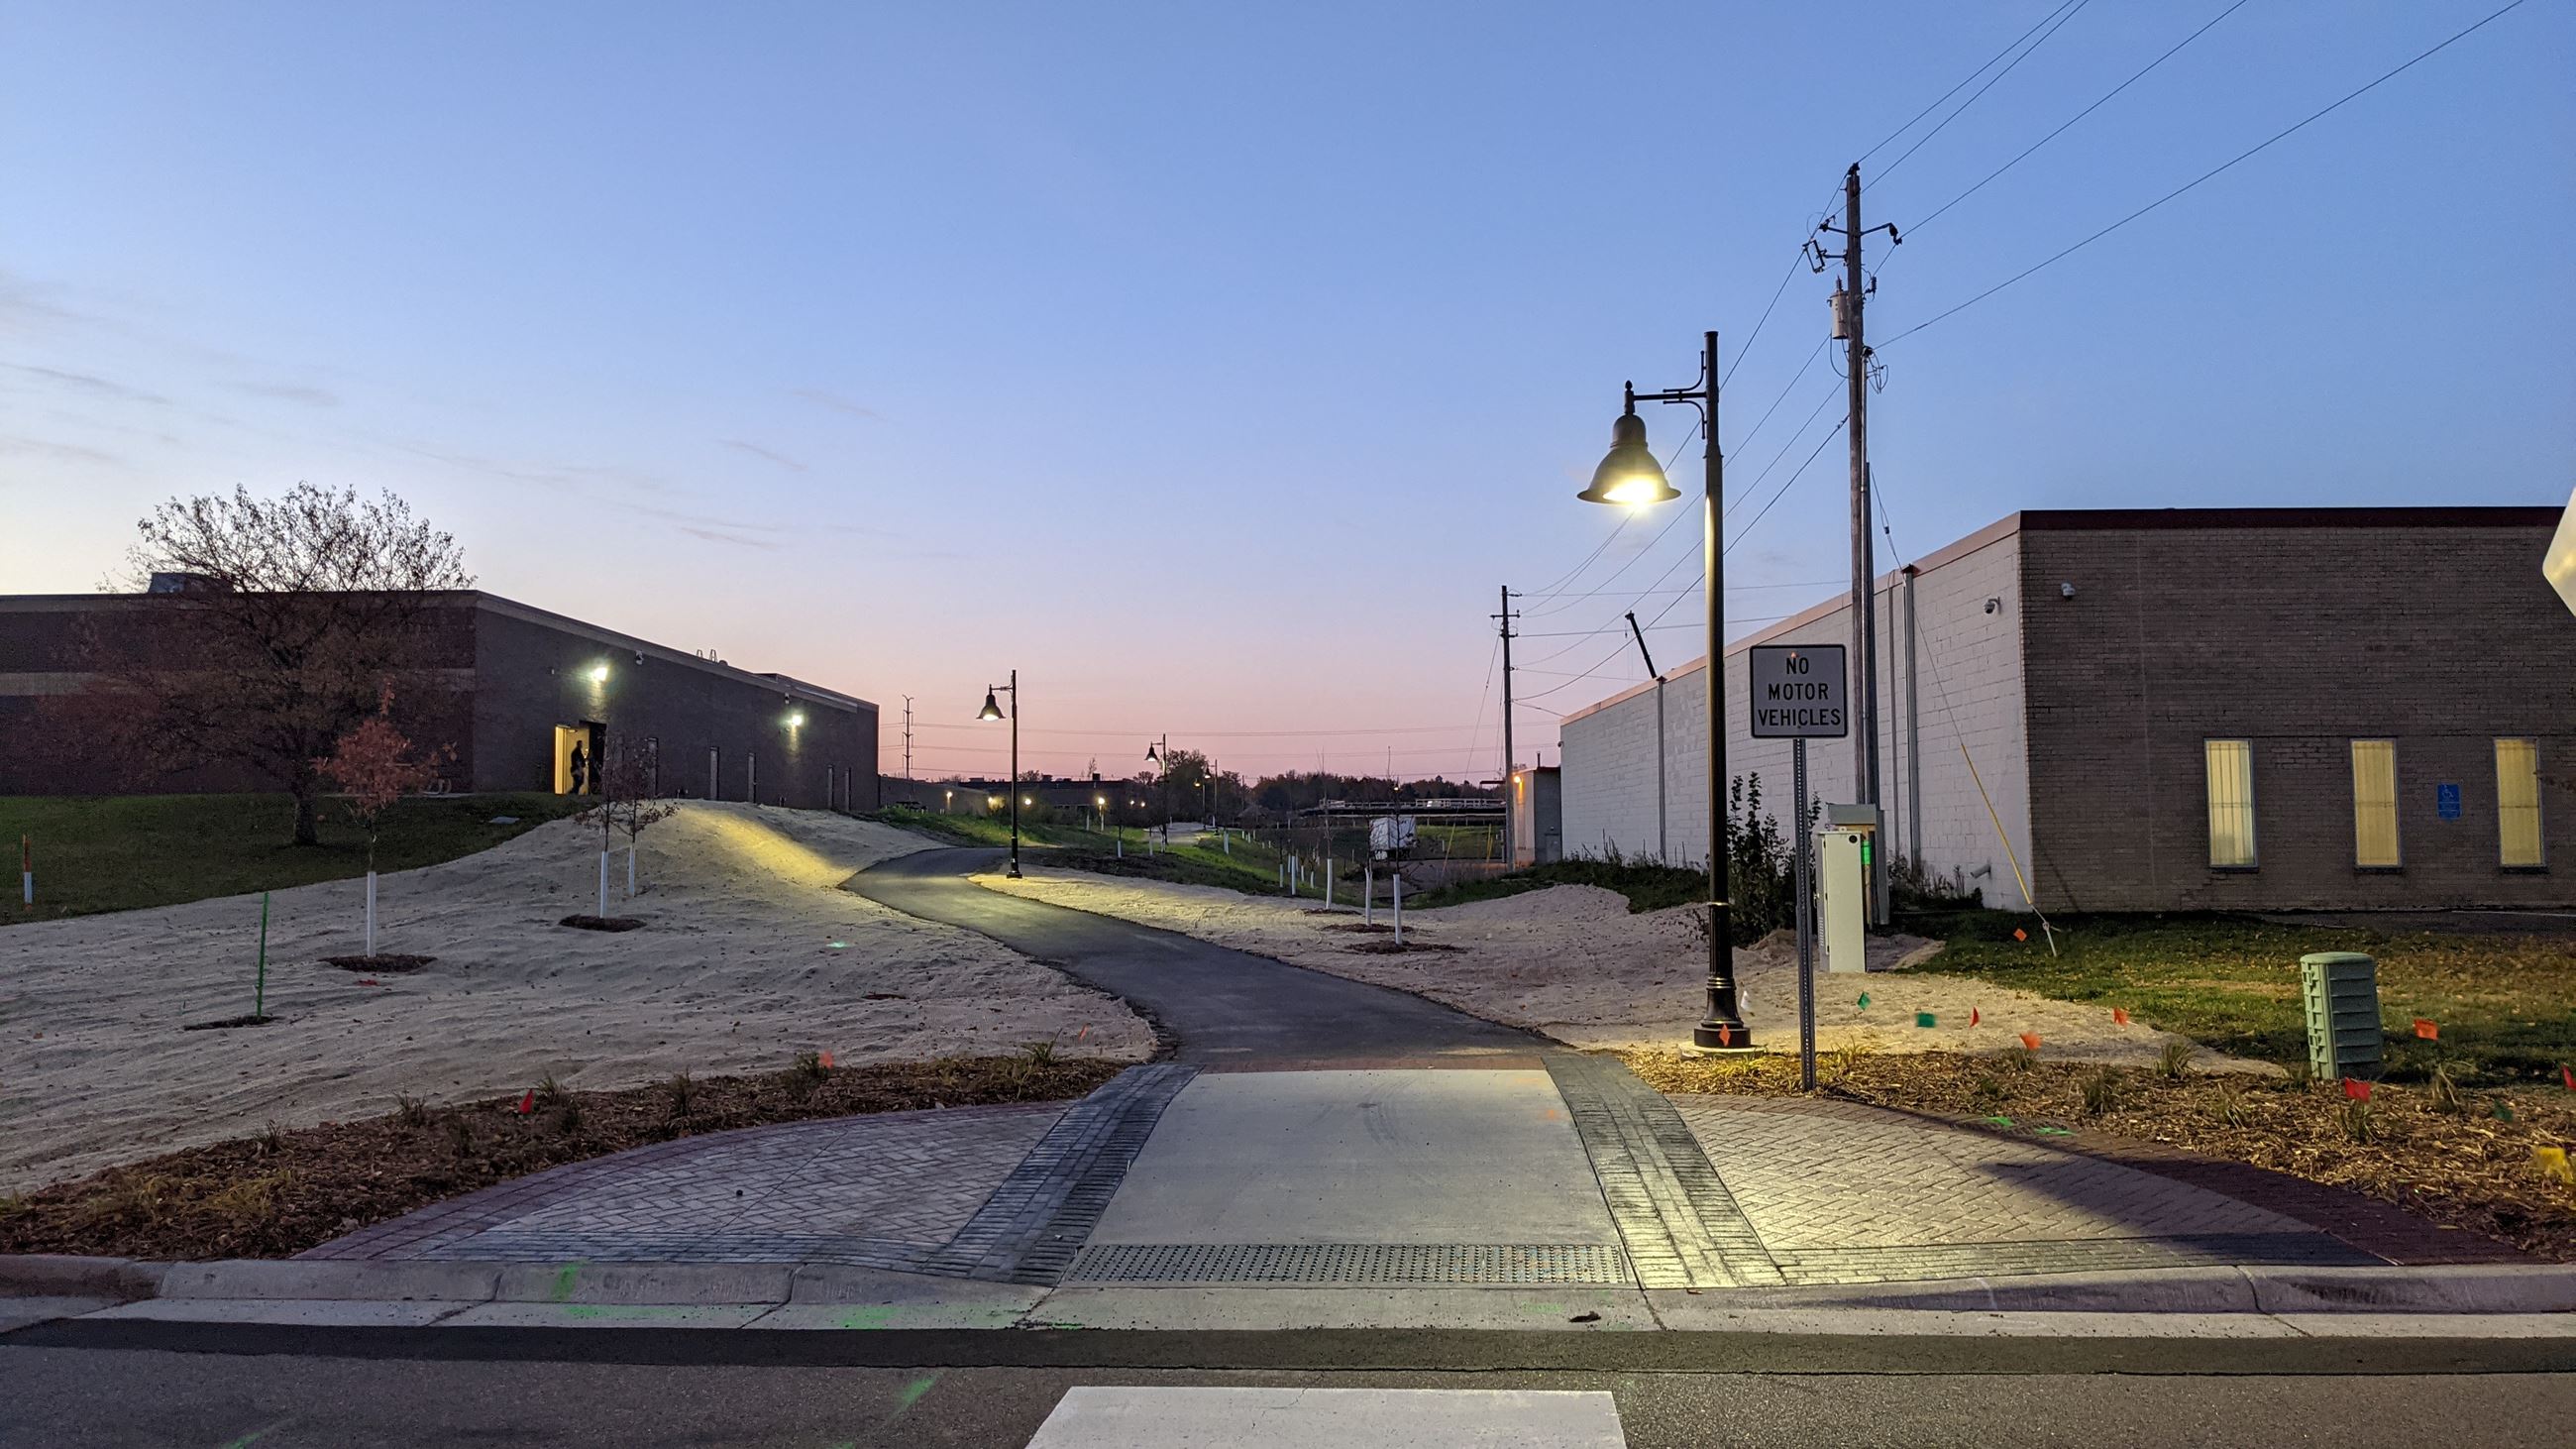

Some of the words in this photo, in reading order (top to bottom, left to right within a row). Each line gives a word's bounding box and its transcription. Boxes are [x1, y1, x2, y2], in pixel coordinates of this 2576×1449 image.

[1786, 657, 1809, 675] NO
[1768, 683, 1829, 701] MOTOR
[1758, 709, 1841, 726] VEHICLES
